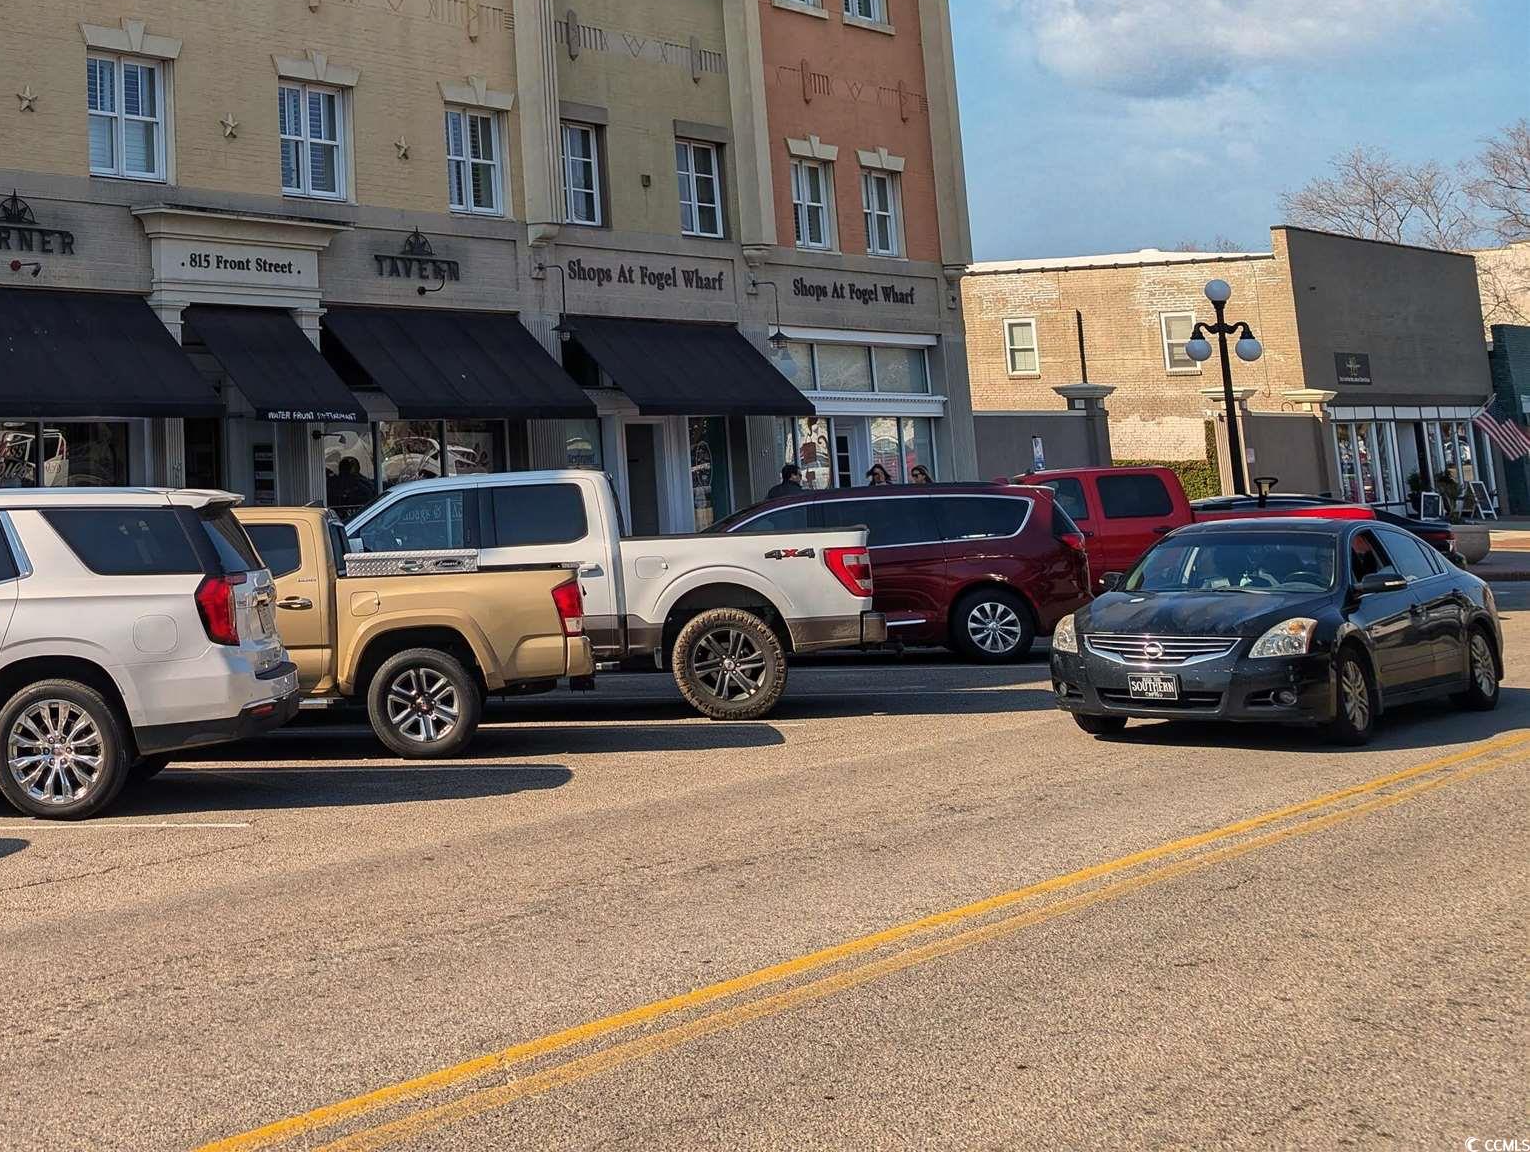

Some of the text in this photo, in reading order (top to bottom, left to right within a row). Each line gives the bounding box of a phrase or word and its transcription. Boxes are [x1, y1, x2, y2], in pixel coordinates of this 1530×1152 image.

[189, 253, 293, 274] 815 Front Street
[373, 254, 460, 281] TAVERN
[567, 258, 724, 291] Shops At Fogel Wharf
[792, 277, 915, 305] Shops At Fogel Wharf
[1131, 680, 1175, 693] SOUTHERN
